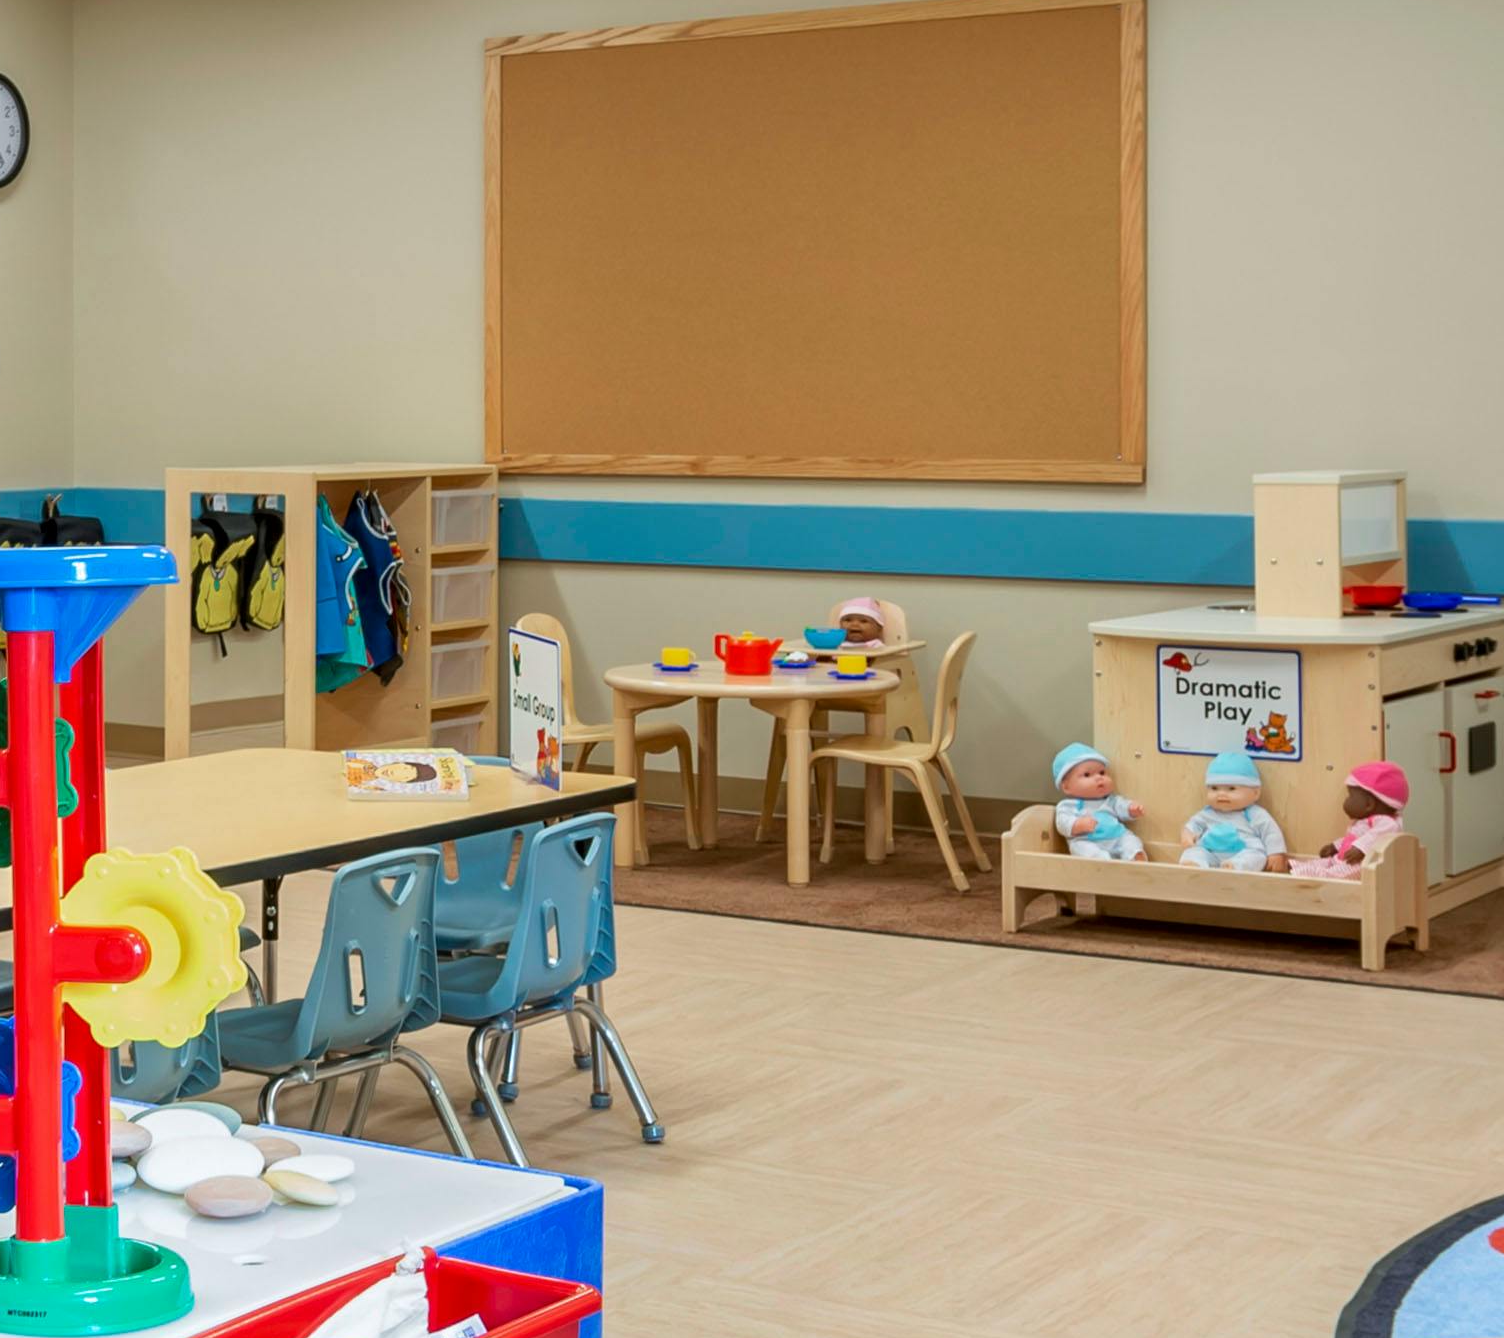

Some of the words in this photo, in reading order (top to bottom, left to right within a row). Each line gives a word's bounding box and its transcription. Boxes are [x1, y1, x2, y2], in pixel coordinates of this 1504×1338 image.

[1176, 677, 1281, 700] Dramatic
[513, 688, 532, 714] Small
[532, 695, 556, 725] Group
[1203, 700, 1253, 725] Play
